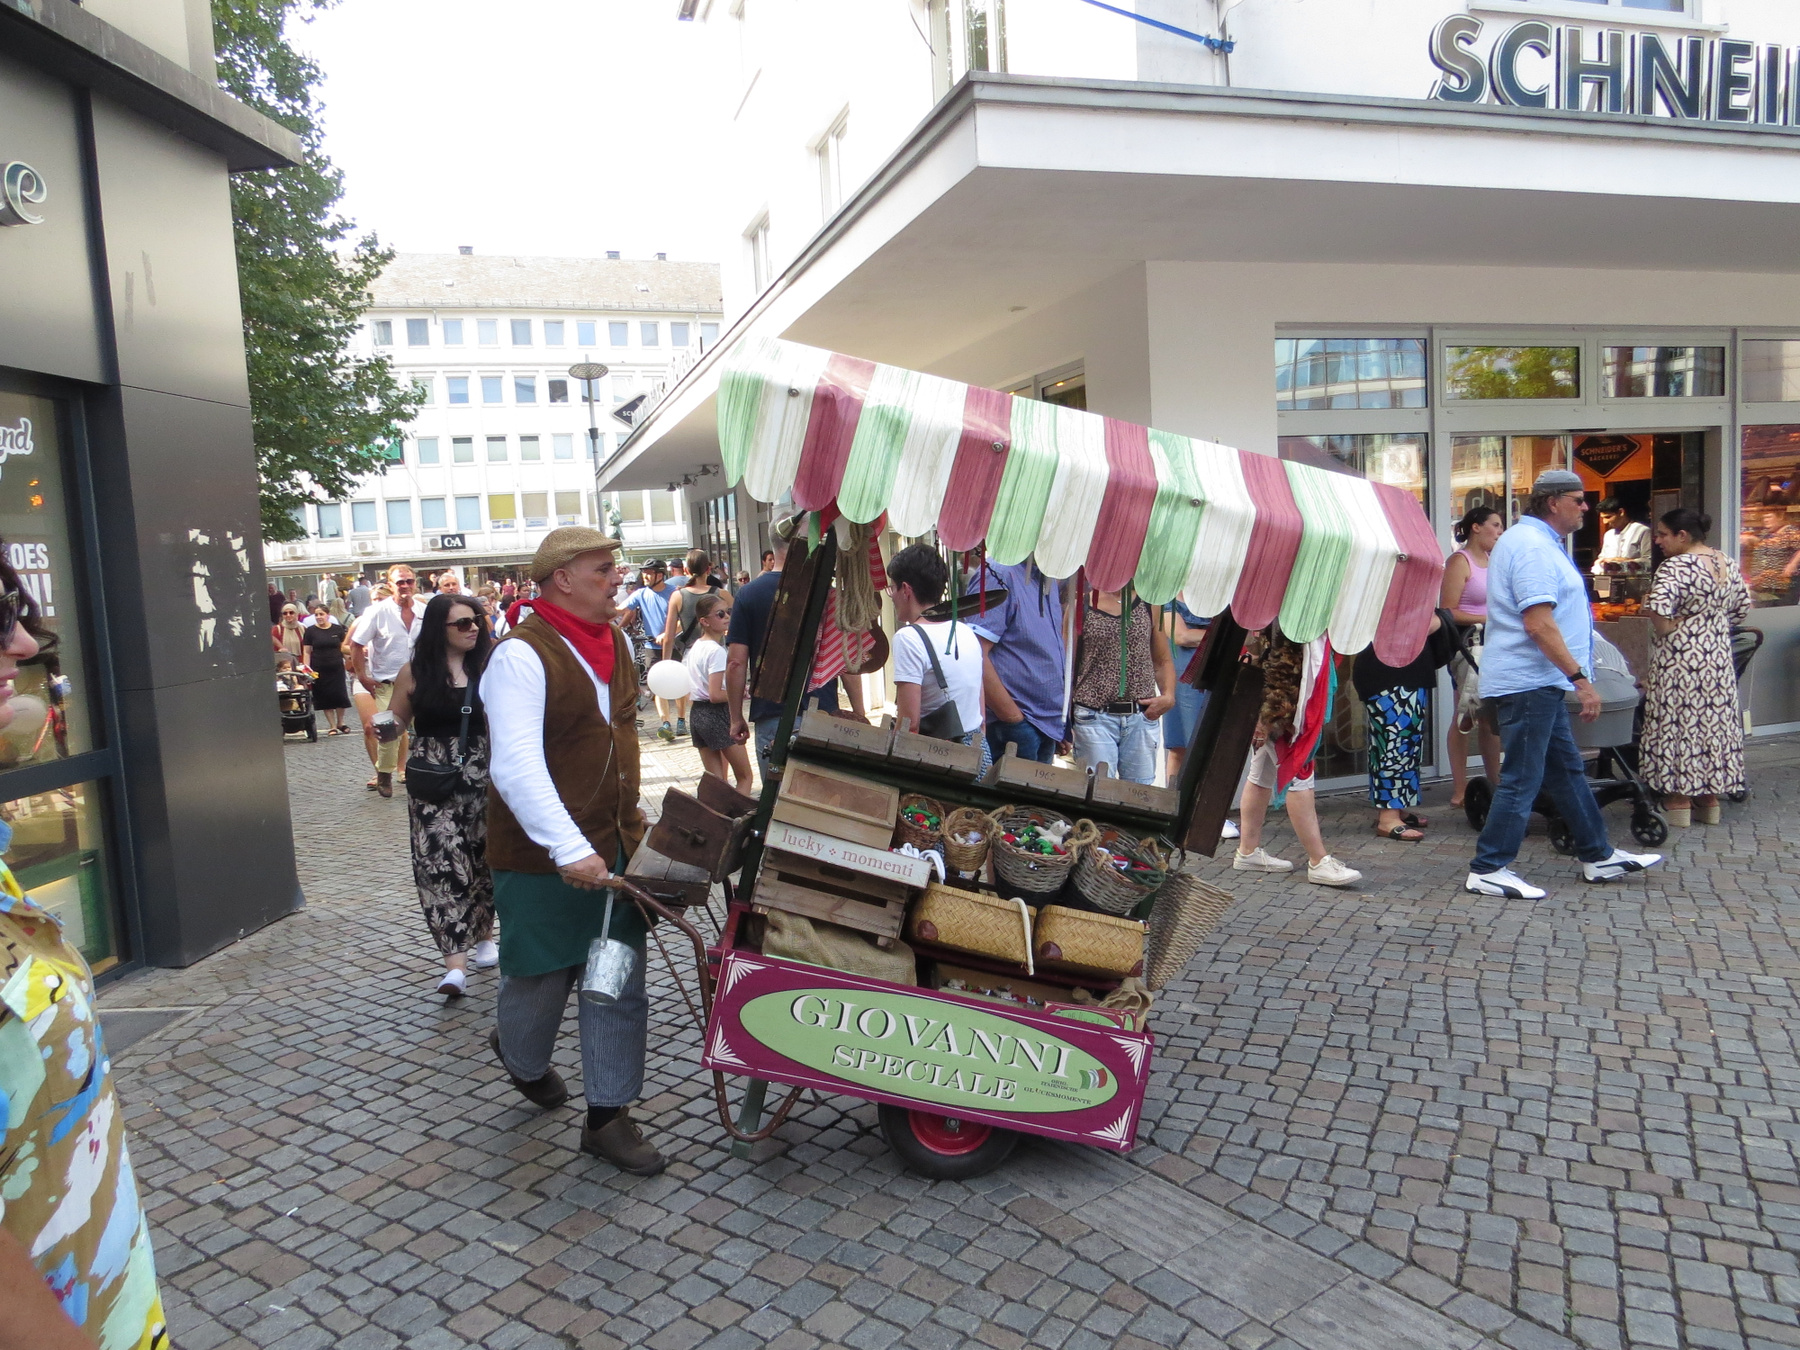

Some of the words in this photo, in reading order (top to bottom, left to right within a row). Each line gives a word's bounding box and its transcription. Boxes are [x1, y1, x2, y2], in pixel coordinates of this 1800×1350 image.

[1427, 13, 1800, 127] SCHNEI
[1580, 444, 1628, 456] SCHNEIDER'S
[838, 725, 861, 738] 1965
[928, 744, 950, 757] 1965
[1034, 769, 1056, 782] 1965
[1128, 787, 1149, 799] 1965
[781, 829, 825, 856] lucky
[841, 849, 914, 877] momenti
[789, 993, 1076, 1079] GIOVANNI
[831, 1044, 1018, 1102] SPECIALE
